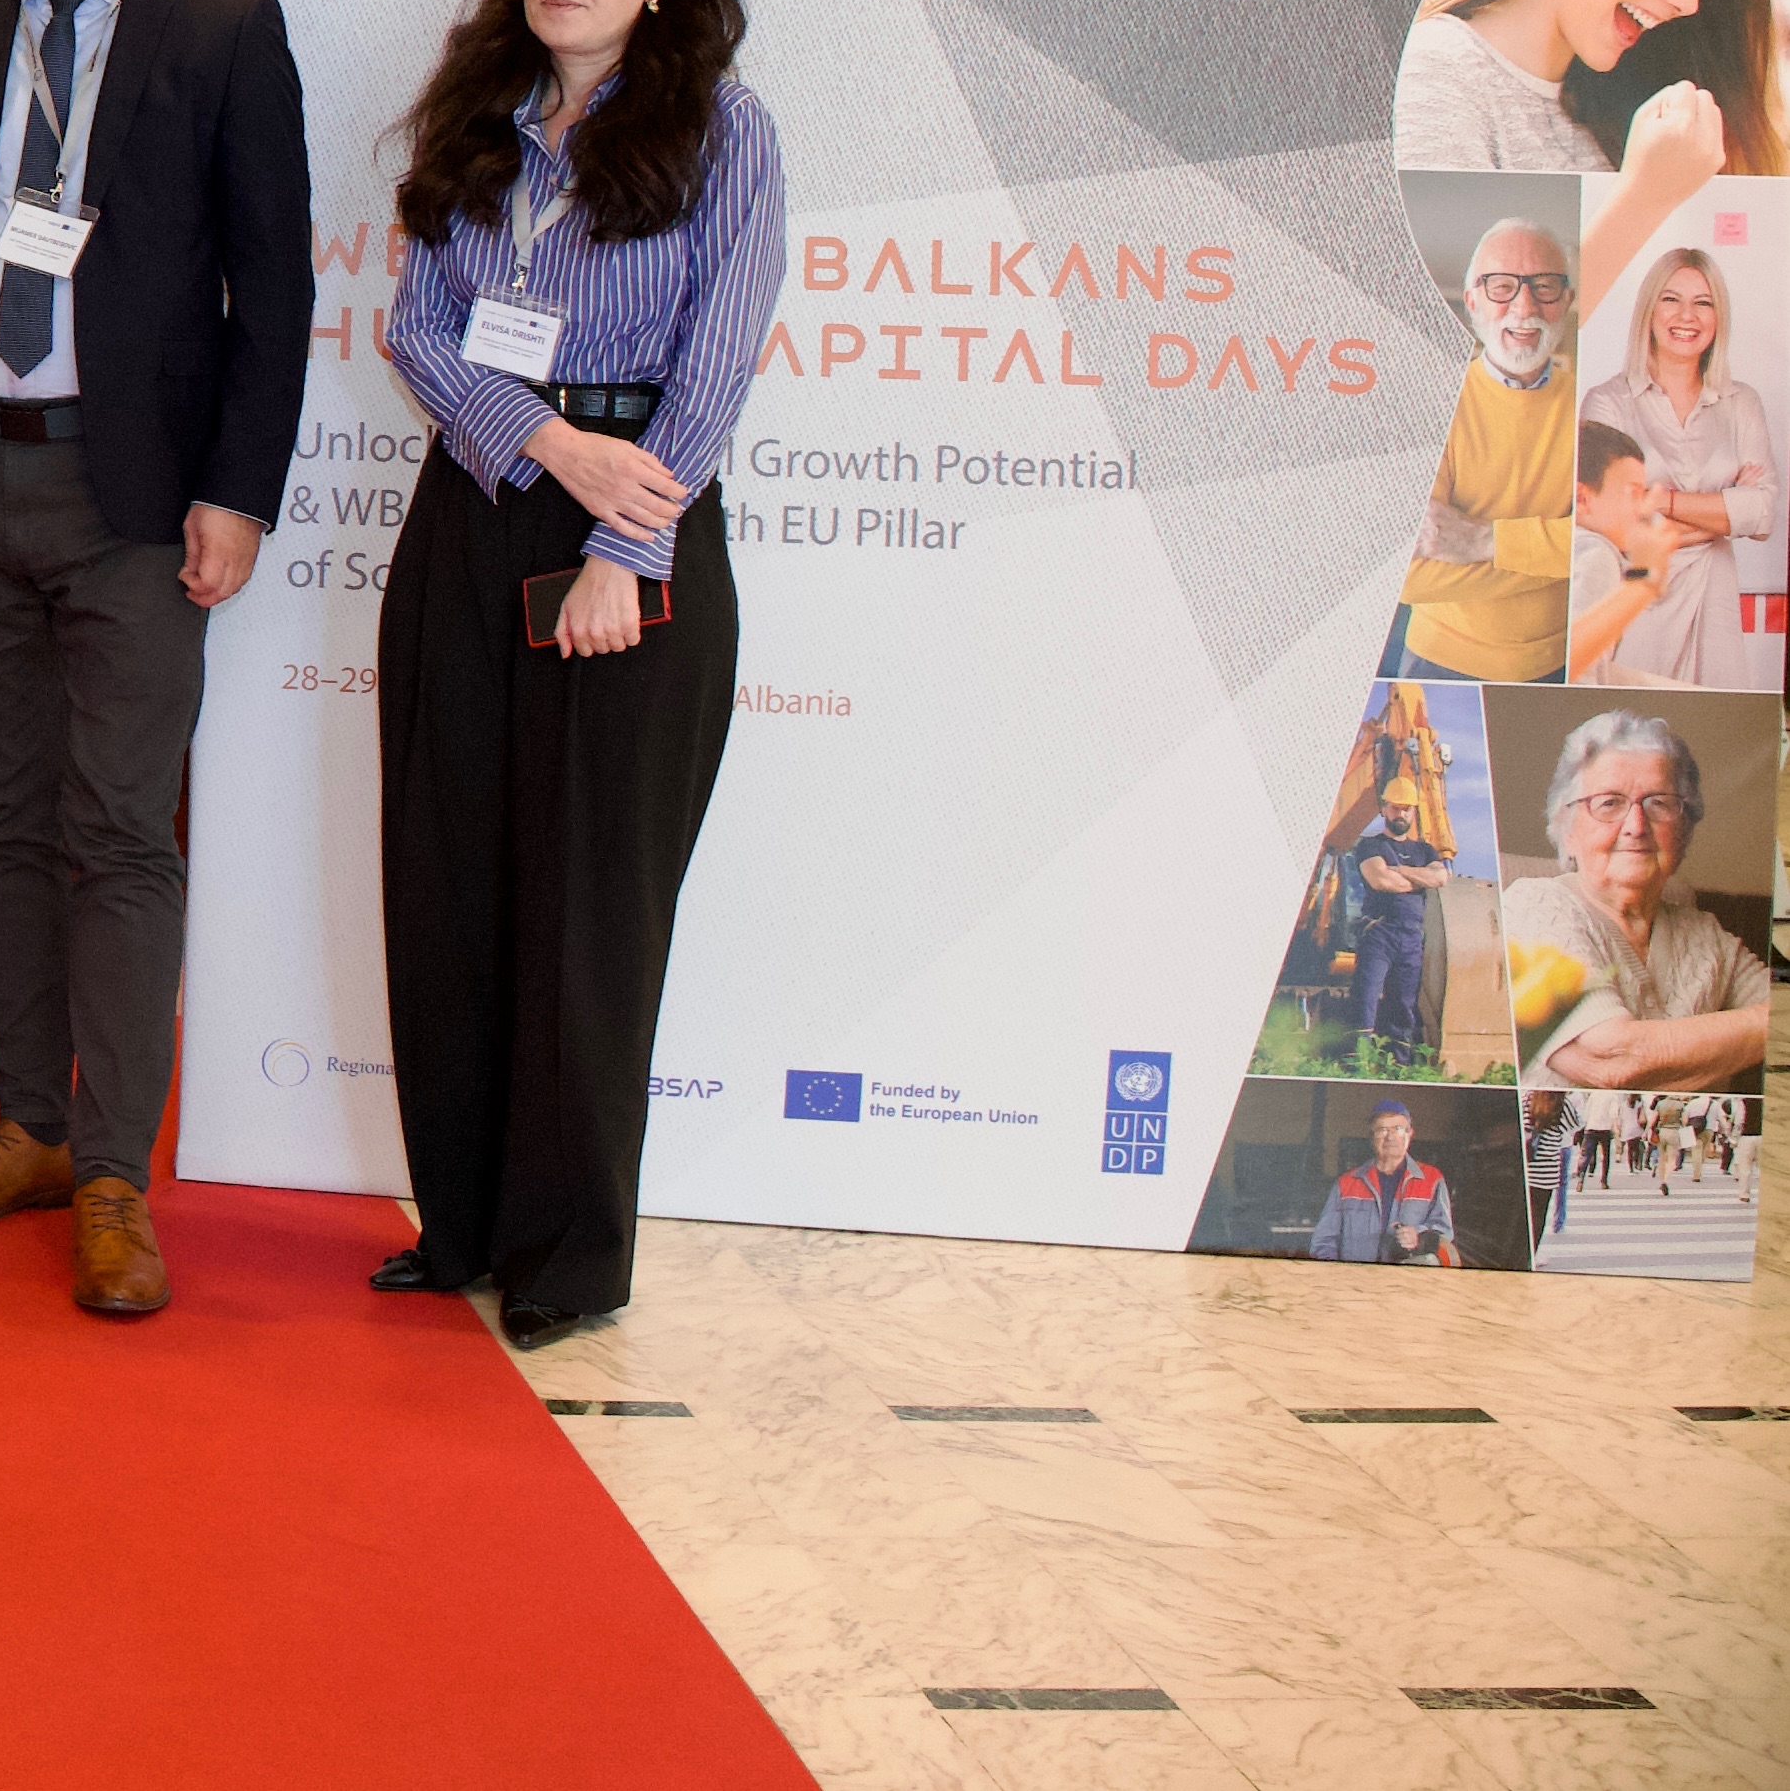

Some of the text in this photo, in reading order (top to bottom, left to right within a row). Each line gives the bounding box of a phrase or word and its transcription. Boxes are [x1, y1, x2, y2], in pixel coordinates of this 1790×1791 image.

[803, 236, 1235, 303] BALKANS
[481, 320, 546, 345] ELVISA DRISHTI
[754, 321, 1378, 395] APITAL DAYS
[295, 422, 432, 463] Unloc
[750, 439, 919, 482] Growth
[935, 445, 1137, 490] Potential
[289, 485, 320, 524] &
[781, 506, 839, 546] EU
[856, 508, 966, 550] Pillar
[287, 549, 334, 588] of
[733, 685, 852, 716] Albania
[327, 1057, 395, 1077] Regiona
[871, 1081, 961, 1103] Funded by
[869, 1103, 1038, 1125] the European Union
